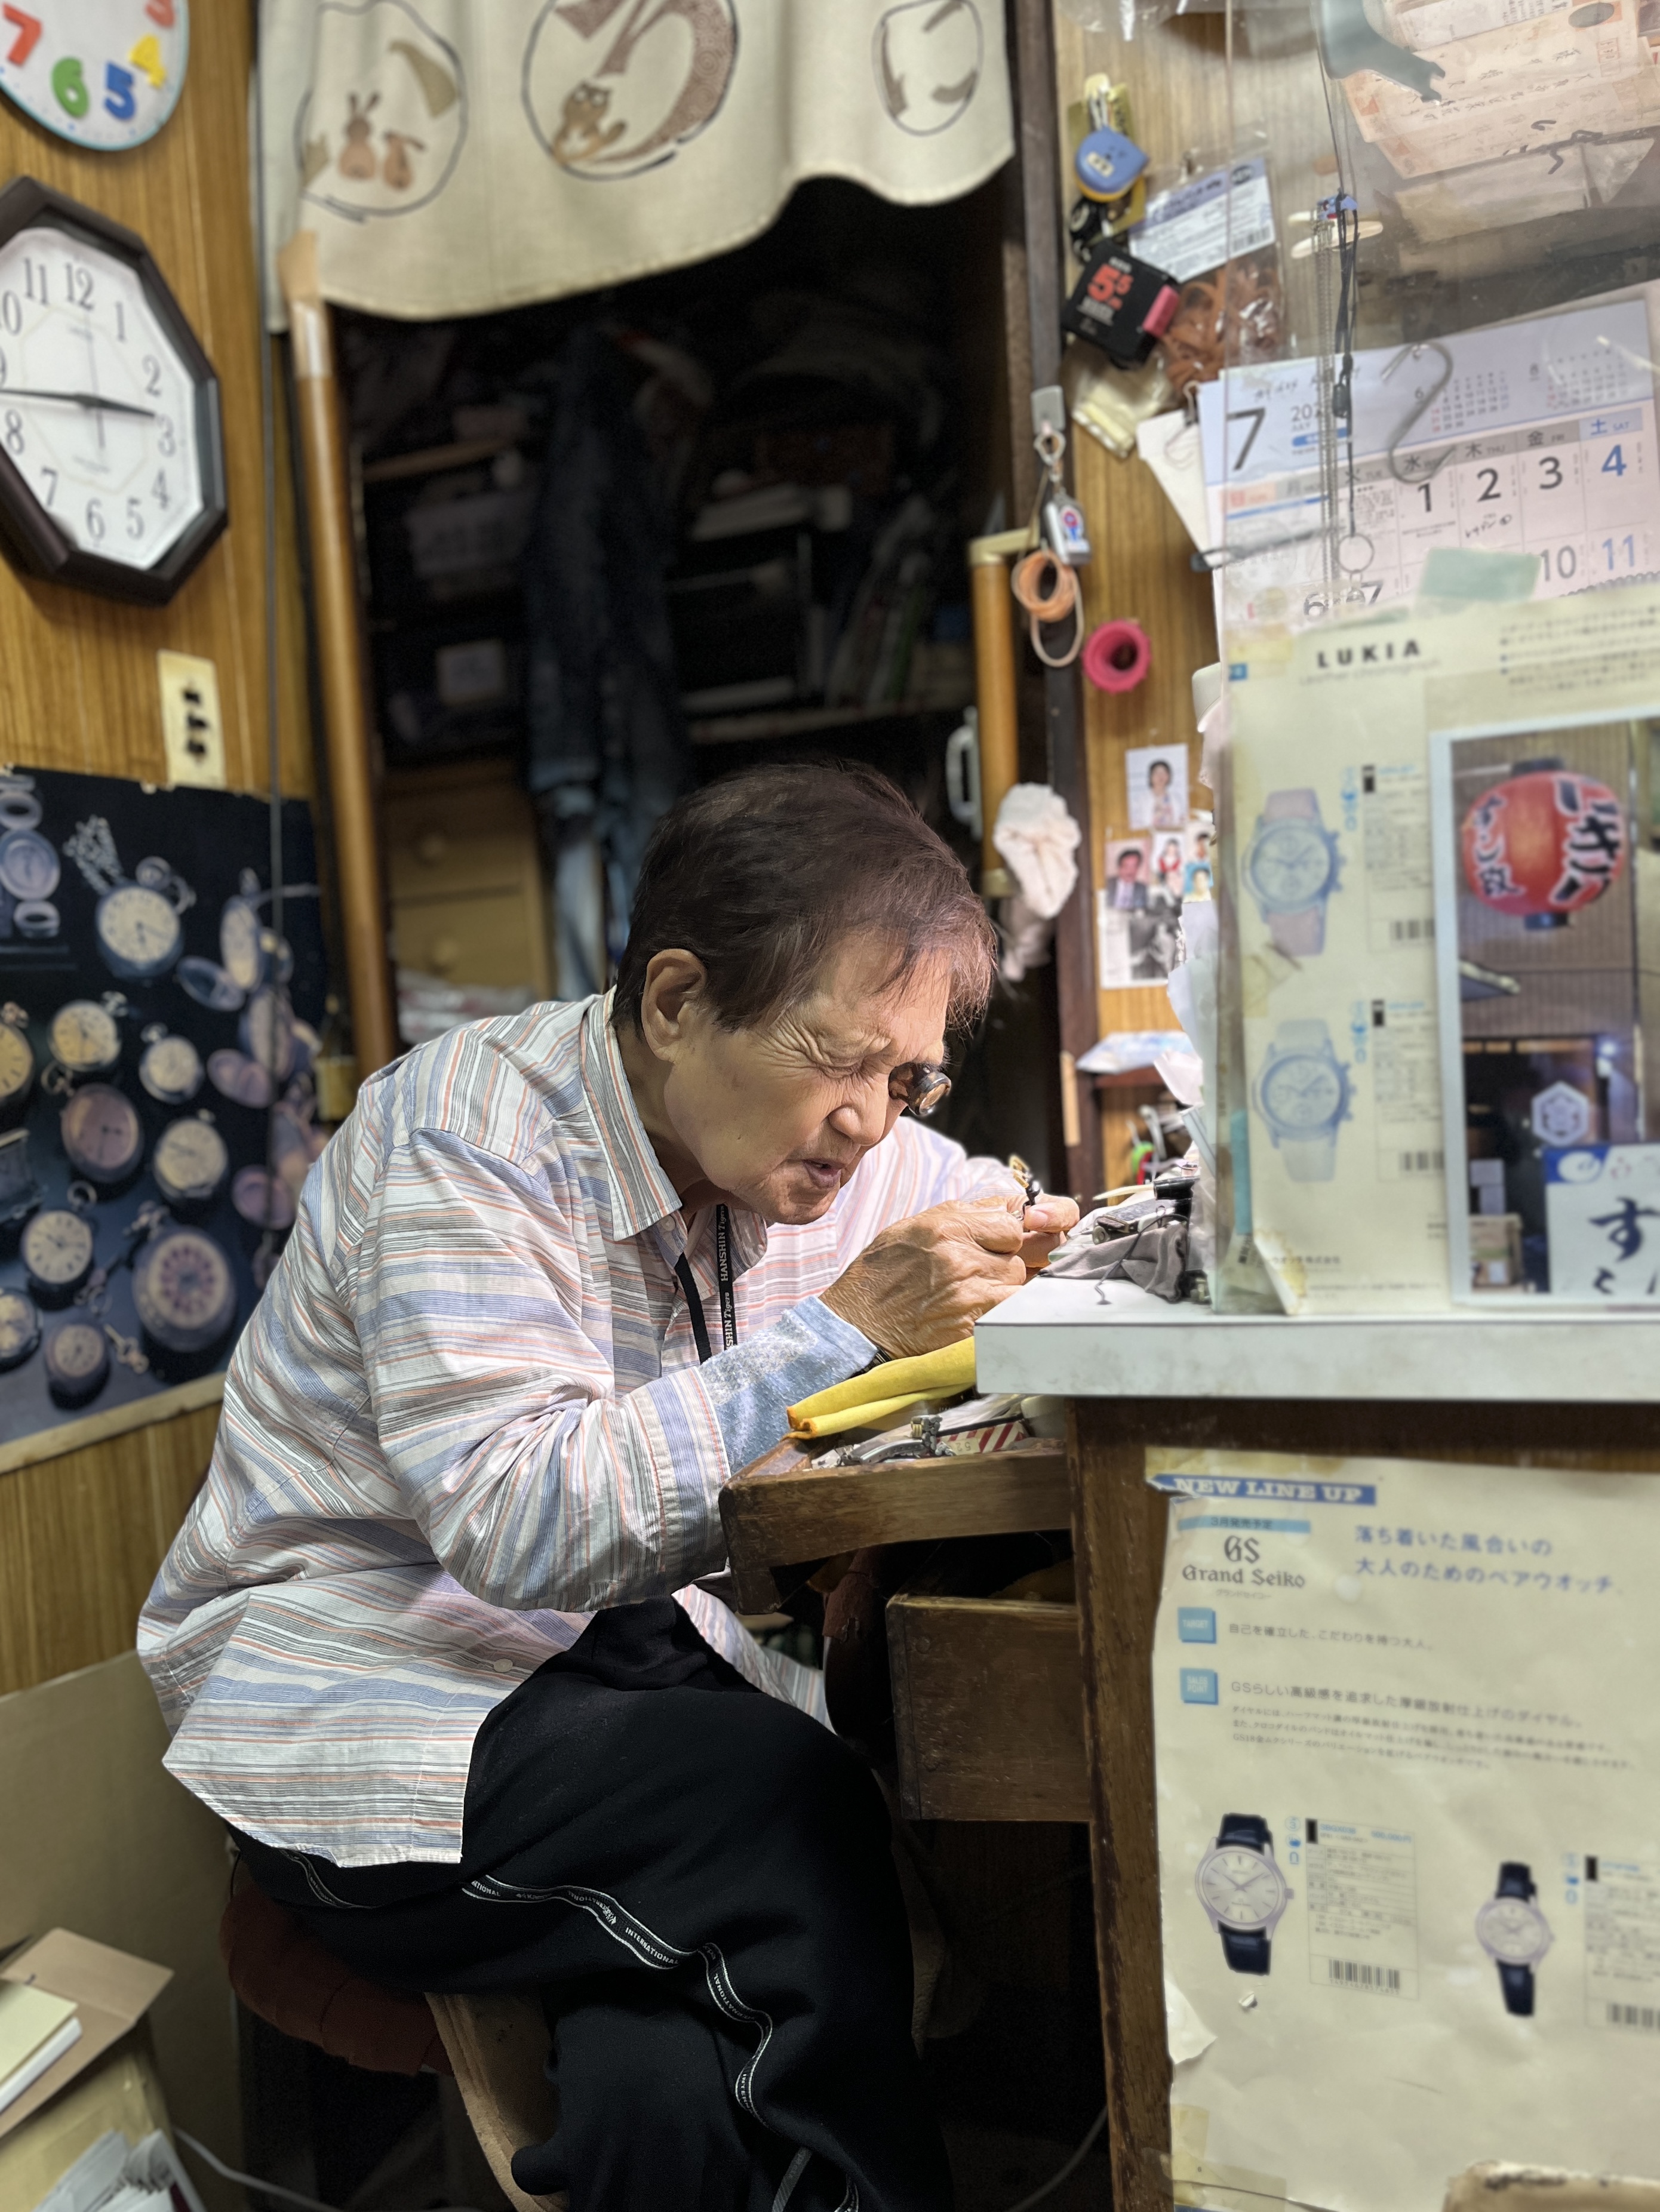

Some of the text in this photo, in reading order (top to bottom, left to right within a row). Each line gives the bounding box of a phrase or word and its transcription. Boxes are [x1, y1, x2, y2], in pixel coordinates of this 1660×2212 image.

[52, 56, 89, 119] 6
[104, 60, 136, 121] 5
[24, 257, 94, 311] 11 12
[0, 290, 22, 336] 0
[142, 355, 161, 397] 2
[5, 410, 24, 456] 8
[1225, 407, 1266, 471] 7
[1465, 444, 1481, 457] 木
[1527, 430, 1544, 446] 金
[1590, 419, 1607, 435] 土
[1417, 482, 1432, 512] 1
[1477, 468, 1502, 503] 2
[1538, 456, 1563, 490] 3
[1601, 444, 1627, 476] 4
[85, 498, 145, 542] 6 5
[1602, 534, 1636, 571] 11
[1317, 639, 1420, 669] LUKIA
[718, 1232, 728, 1282] HANSHIN
[724, 1292, 733, 1319] Tigers
[955, 1441, 972, 1452] 52
[1174, 1478, 1363, 1502] NEW LINE UP
[1210, 1516, 1273, 1530] 3月発売予定
[1224, 1534, 1261, 1564] GS
[1182, 1564, 1306, 1589] Grand Seiko
